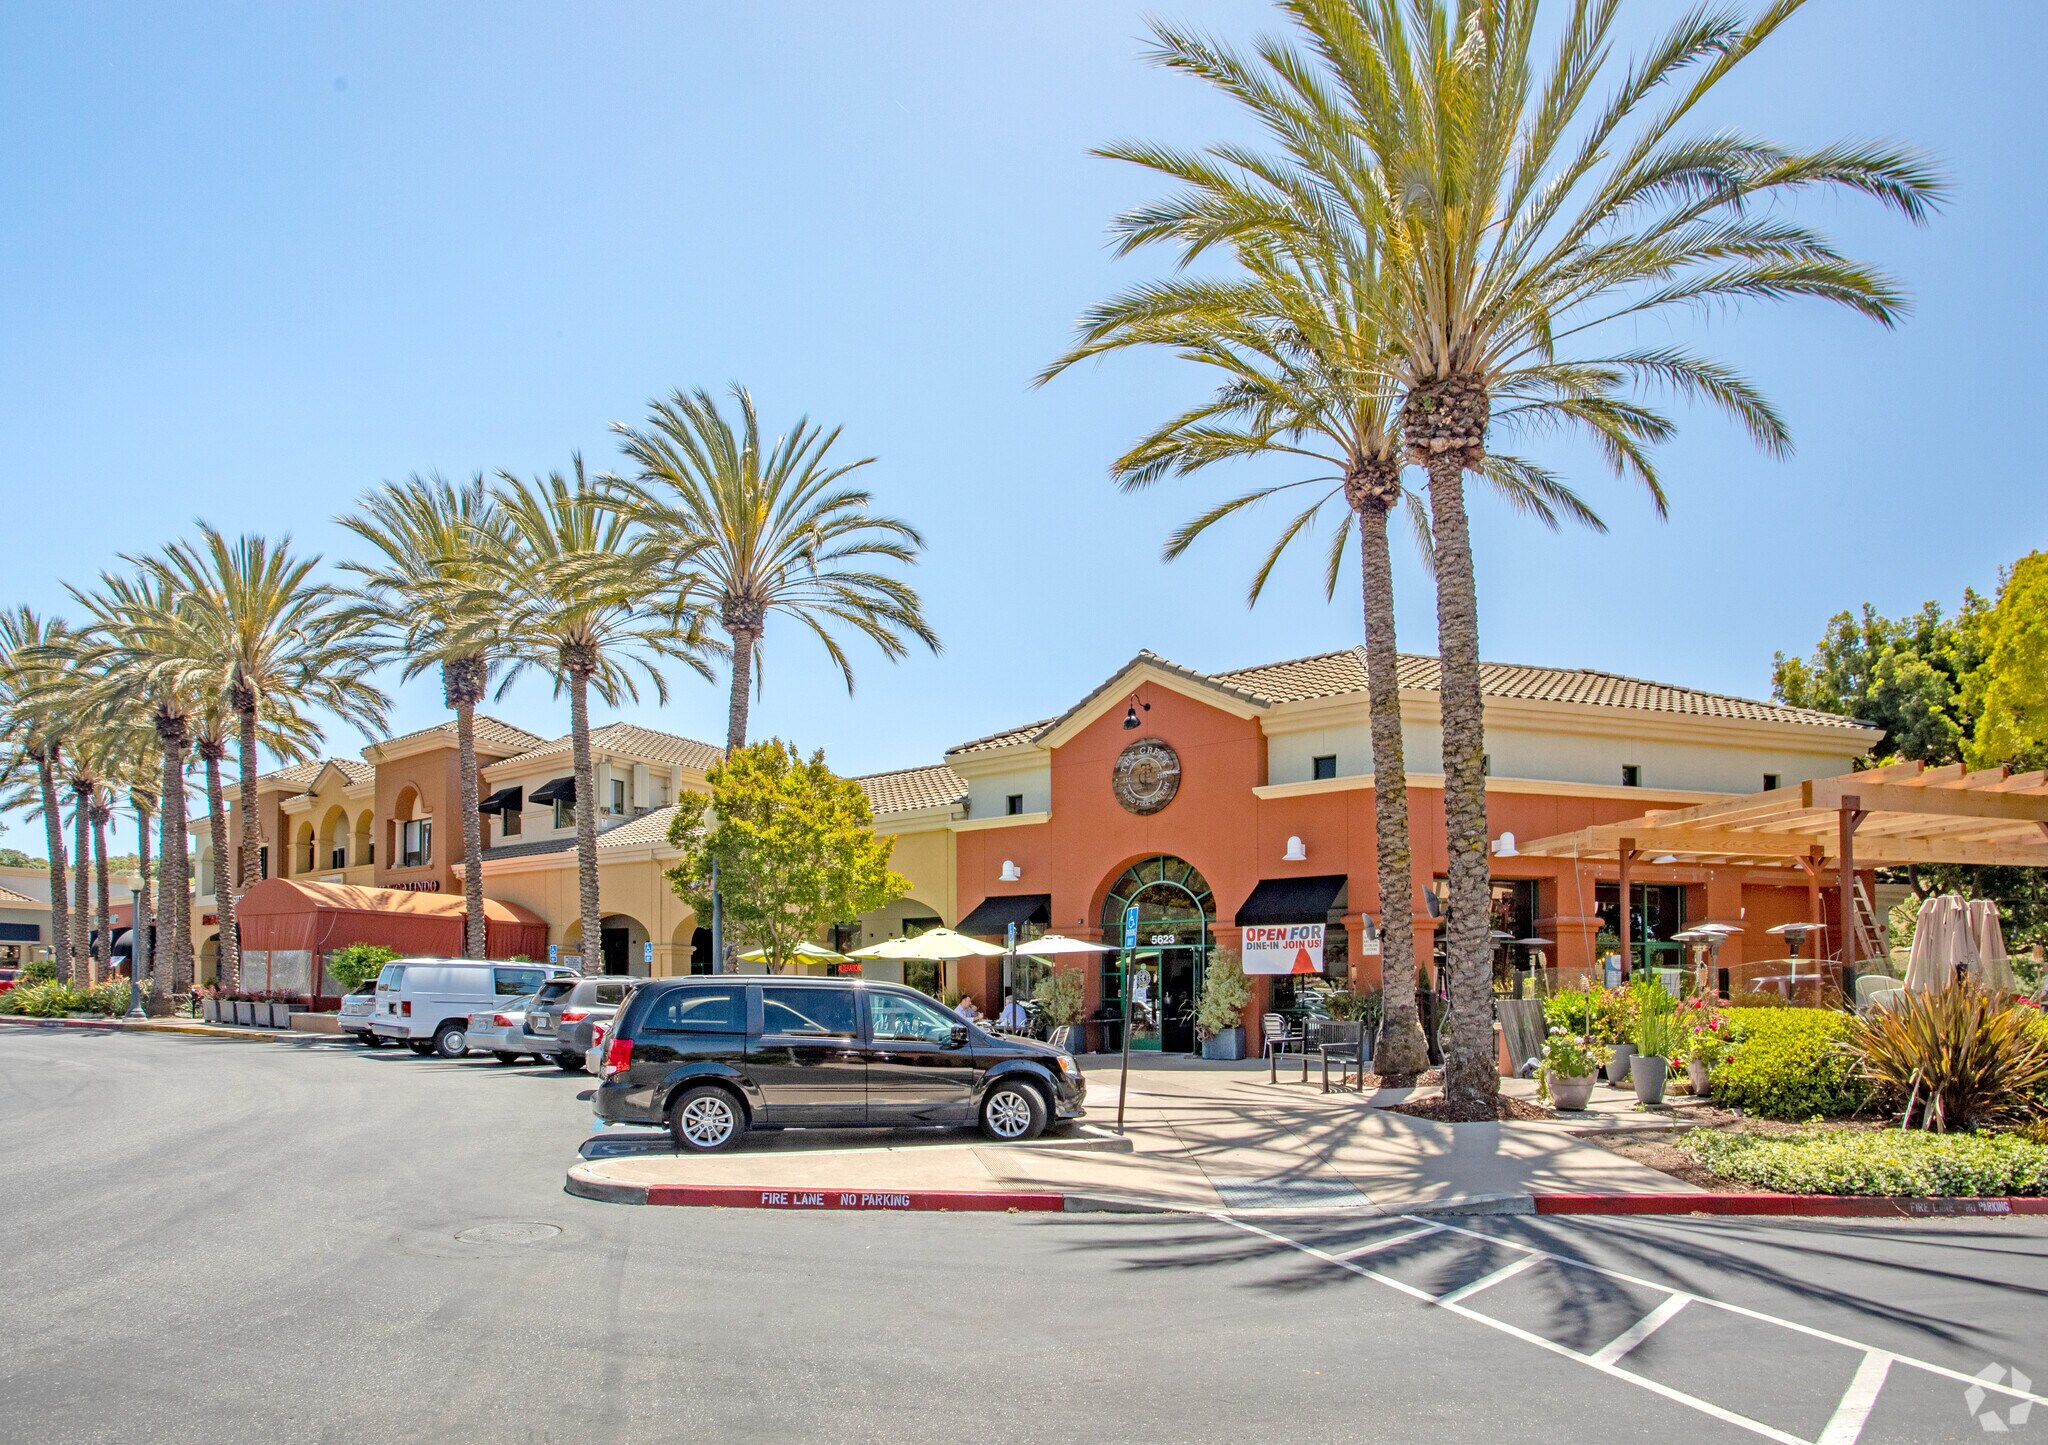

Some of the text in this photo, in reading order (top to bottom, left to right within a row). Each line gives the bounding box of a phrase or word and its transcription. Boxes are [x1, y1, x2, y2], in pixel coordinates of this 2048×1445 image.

[1121, 746, 1169, 772] THE CREEK
[1123, 788, 1136, 803] WOOD
[1152, 781, 1170, 803] EATERY
[1151, 935, 1175, 944] 5623
[1246, 925, 1322, 941] OPEN FOR
[1246, 939, 1323, 951] DINE-IN JOIN US!
[761, 1192, 910, 1207] FIRE LANE NO PARKING
[1910, 1202, 1930, 1212] FIRE
[1979, 1202, 2009, 1211] PARKING
